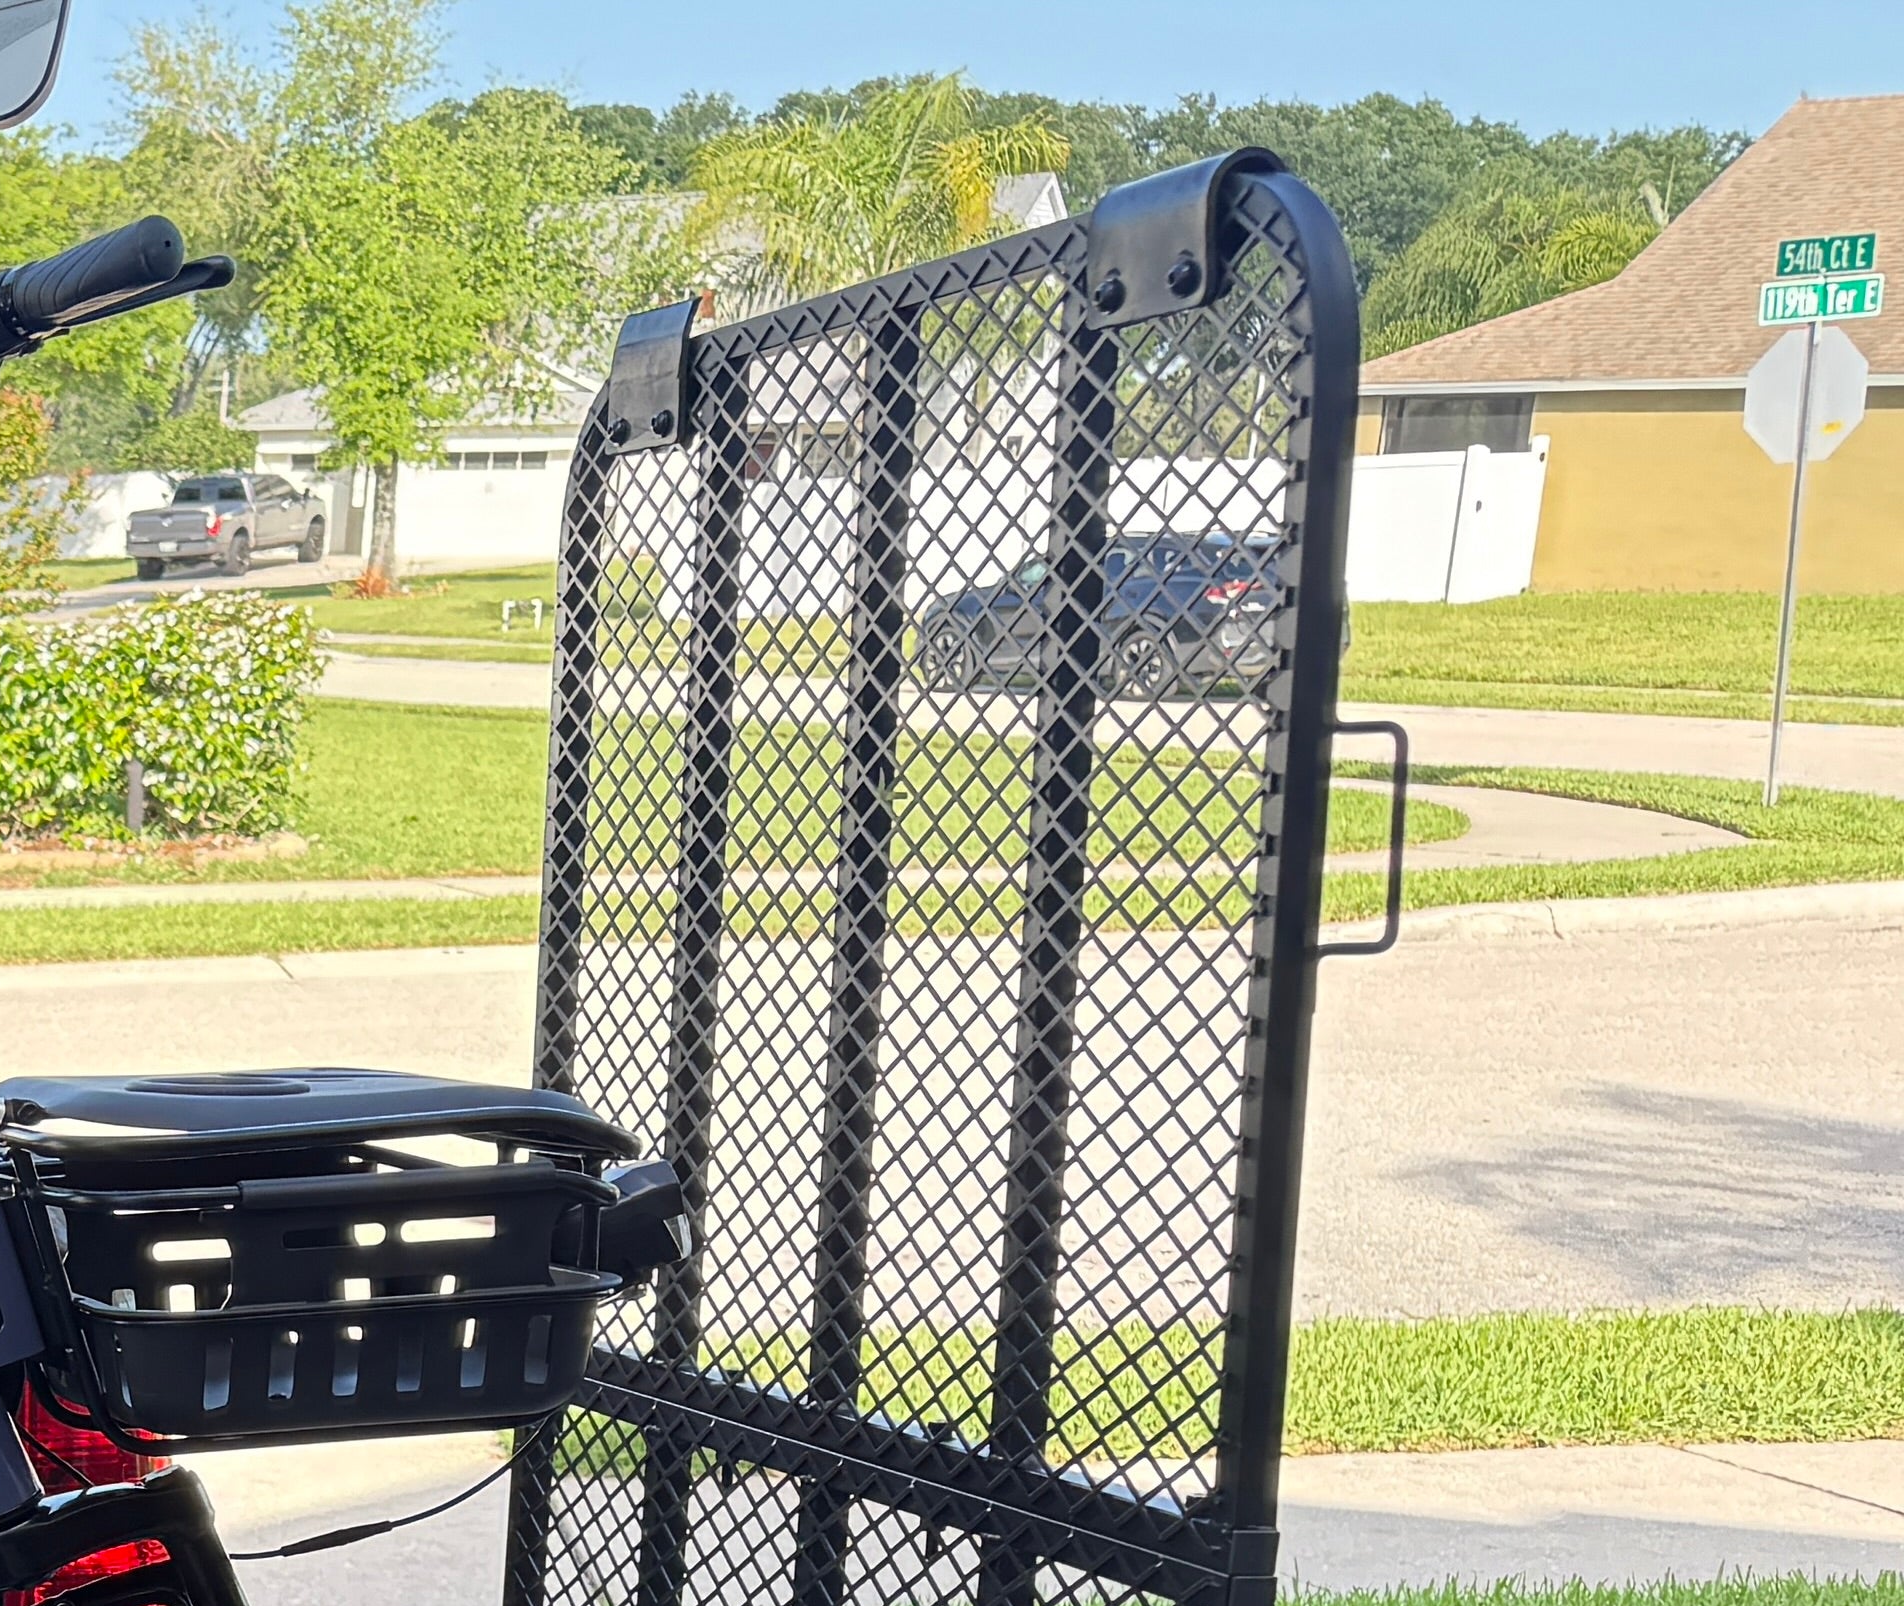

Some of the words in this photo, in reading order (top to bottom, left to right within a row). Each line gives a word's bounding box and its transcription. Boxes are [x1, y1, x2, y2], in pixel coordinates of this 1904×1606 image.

[1783, 241, 1824, 273] 54th
[1829, 239, 1850, 269] Ct
[1855, 237, 1869, 268] E
[1766, 285, 1819, 319] 119th
[1826, 282, 1858, 314] Ter
[1863, 279, 1879, 312] E
